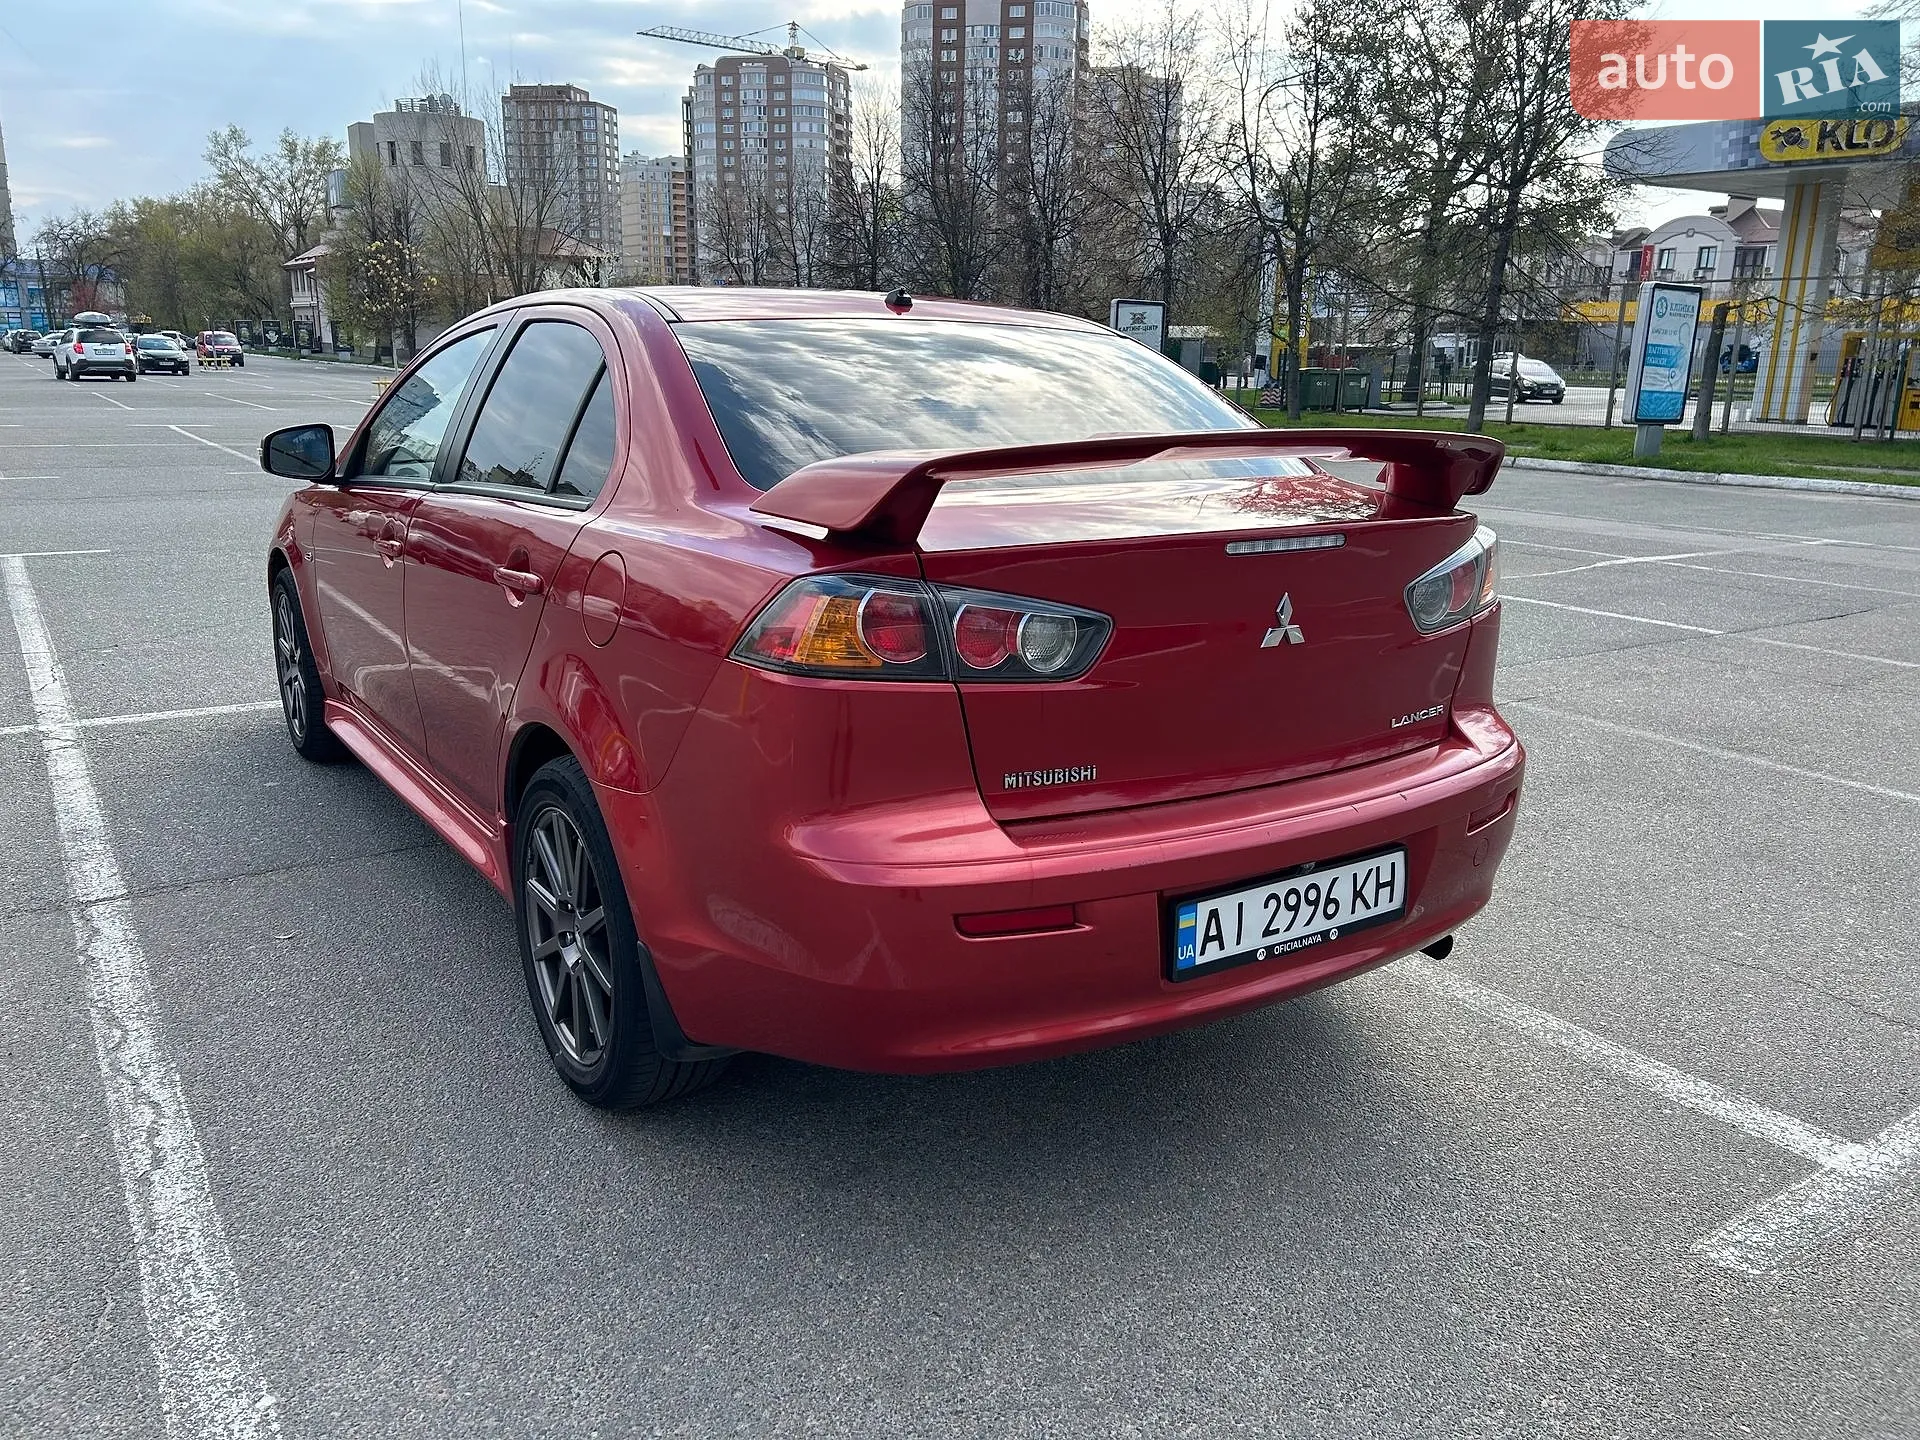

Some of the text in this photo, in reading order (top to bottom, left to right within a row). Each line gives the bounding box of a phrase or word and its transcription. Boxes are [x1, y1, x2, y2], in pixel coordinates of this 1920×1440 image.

[1816, 116, 1896, 152] KLO
[1391, 705, 1443, 728] LANCER
[1004, 765, 1096, 789] MITSUBISHI
[1200, 862, 1396, 957] AI 2996 KH
[1178, 944, 1195, 960] UA
[1274, 934, 1322, 955] OFICIALNAYA
